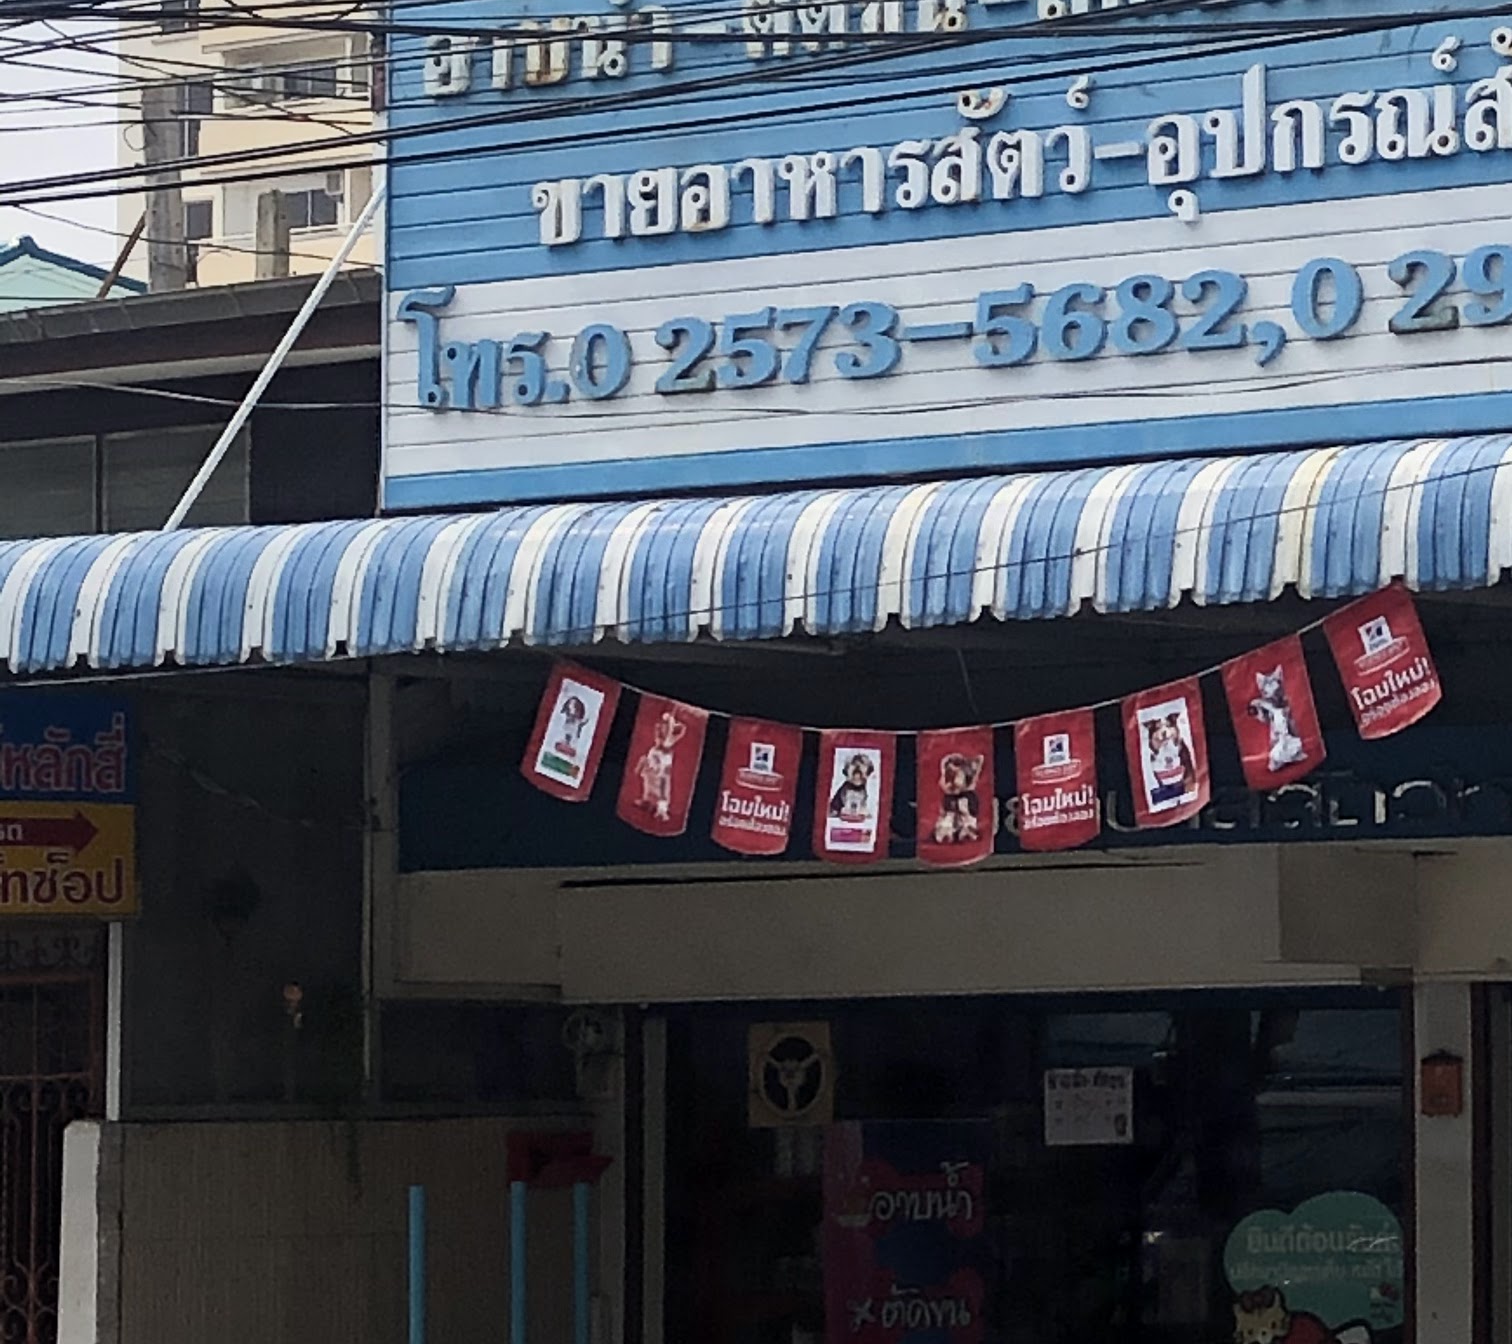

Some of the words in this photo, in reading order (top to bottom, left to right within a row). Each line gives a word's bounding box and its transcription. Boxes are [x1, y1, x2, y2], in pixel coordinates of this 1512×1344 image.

[0, 711, 127, 792] หลักสี่
[0, 855, 124, 904] ทช็อป
[874, 1160, 973, 1221] อาบน้ำ
[881, 1283, 972, 1329] ตัดขน
